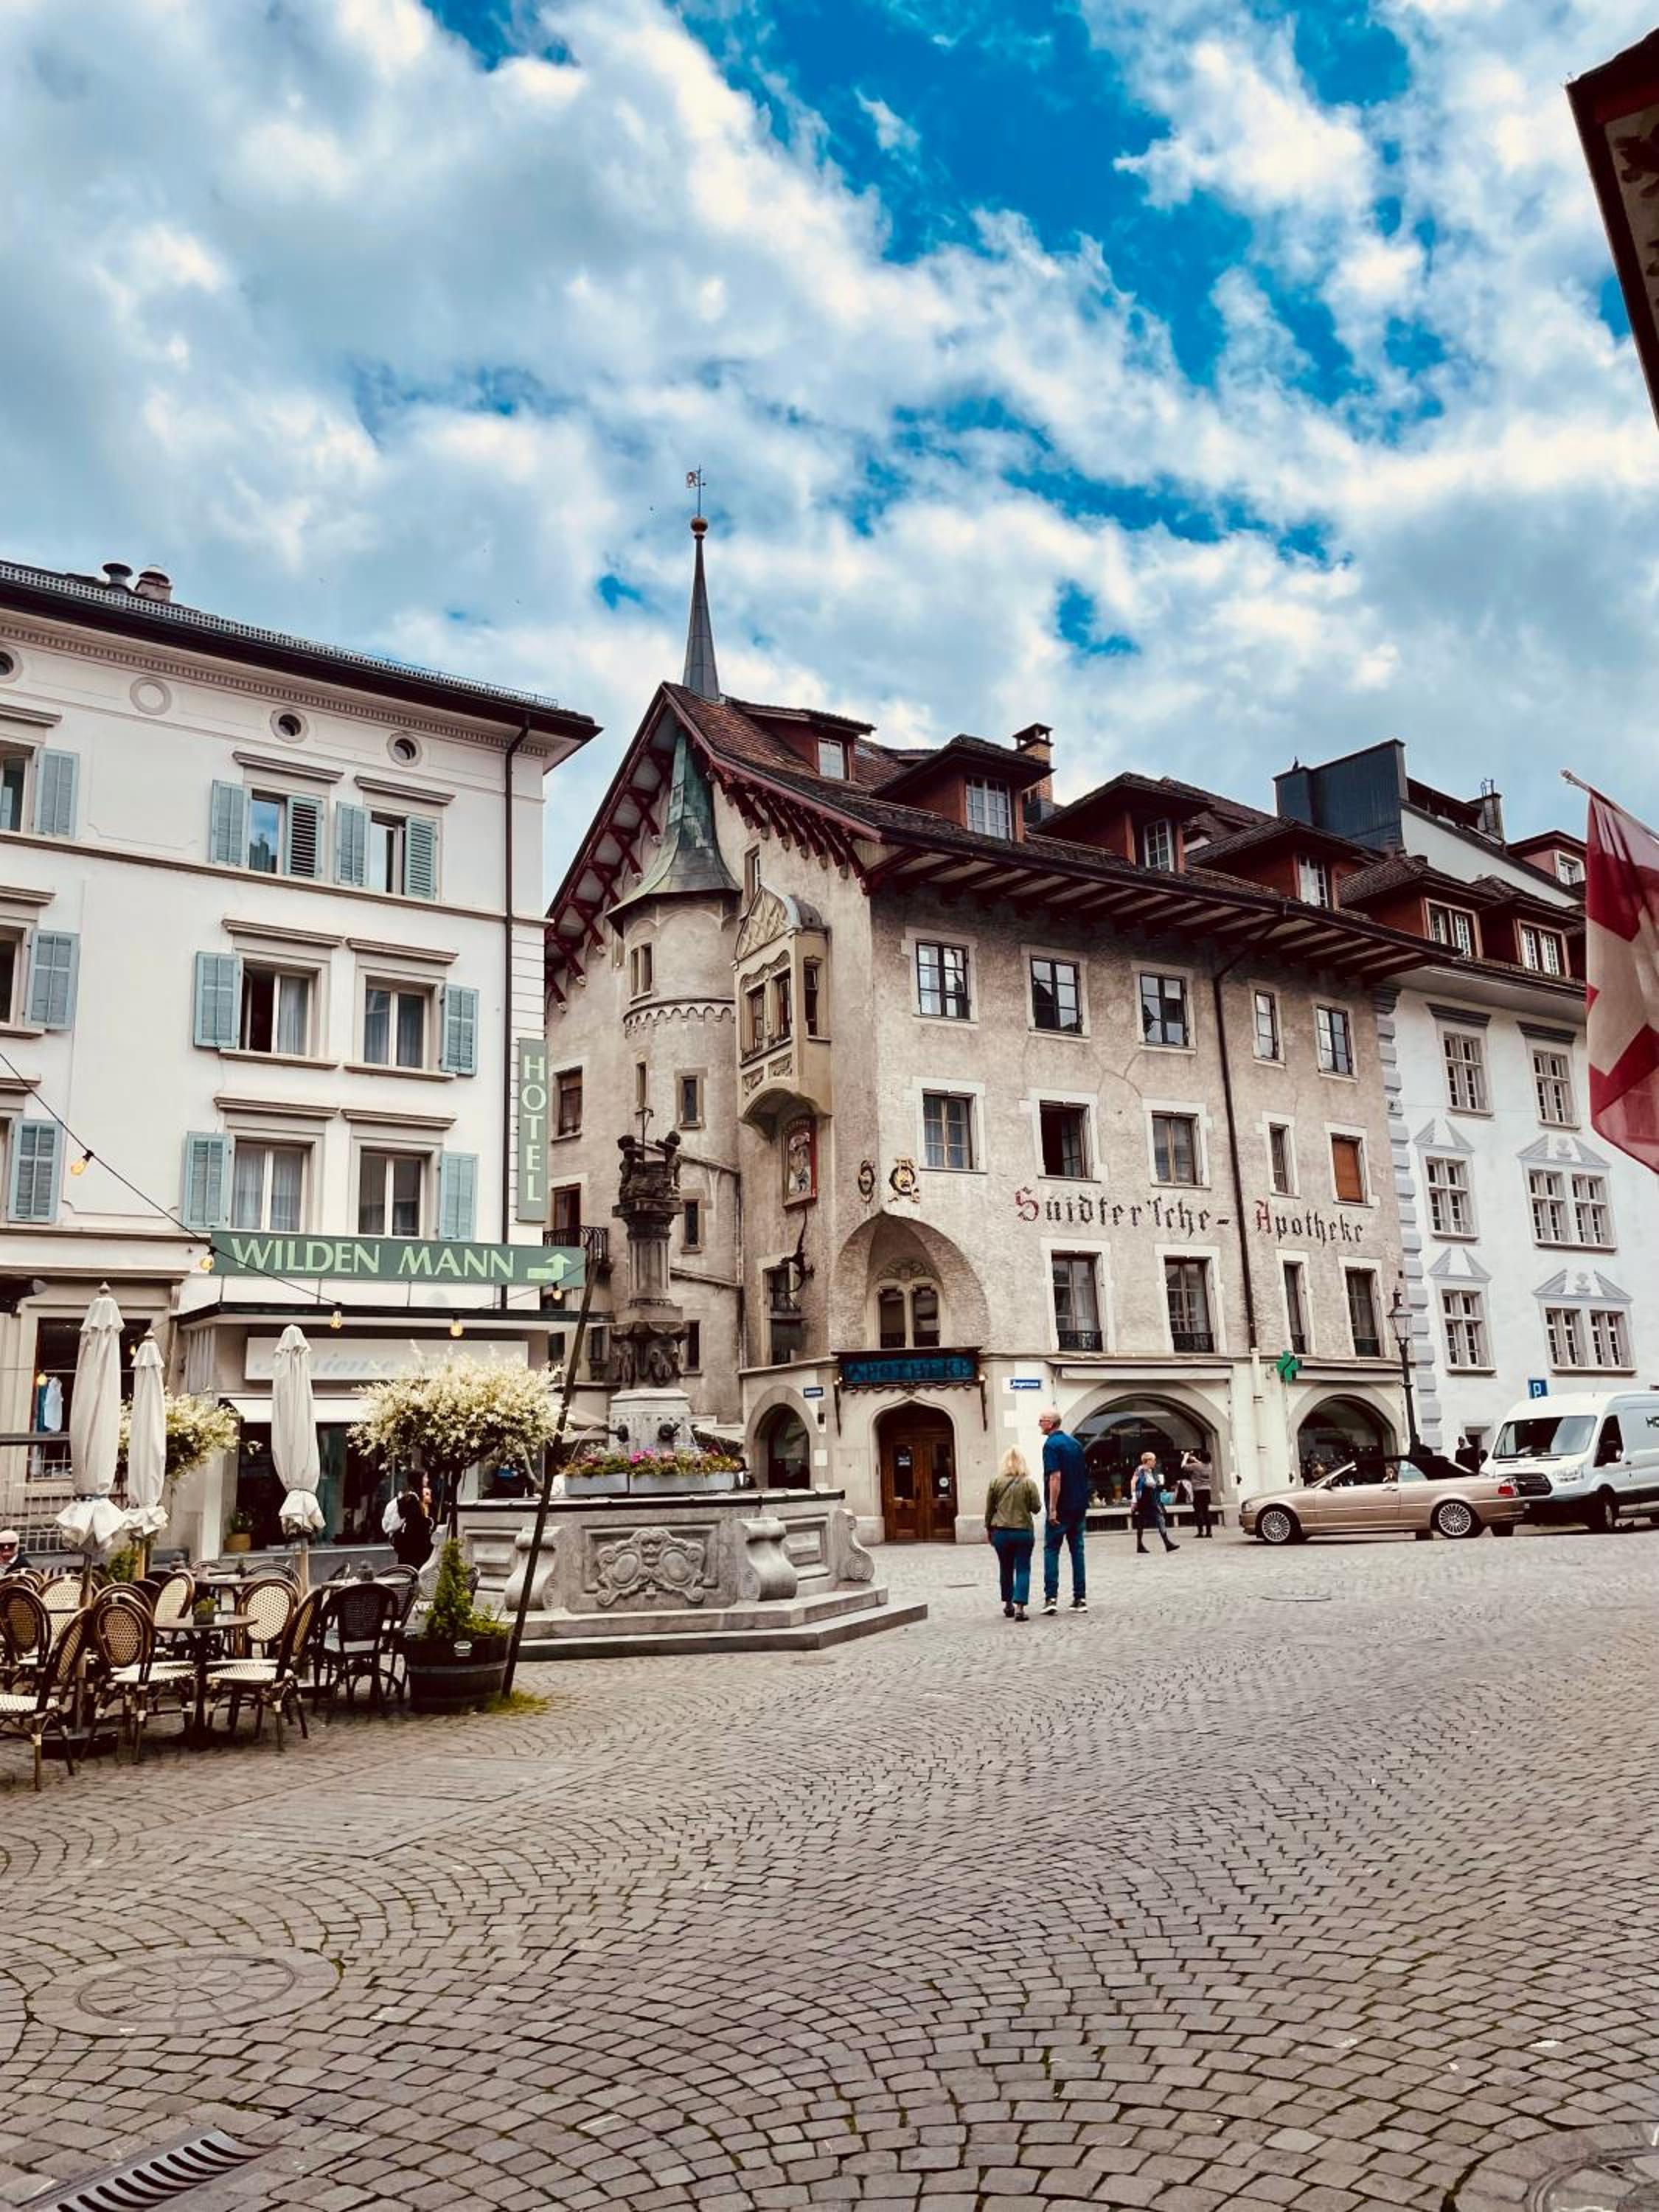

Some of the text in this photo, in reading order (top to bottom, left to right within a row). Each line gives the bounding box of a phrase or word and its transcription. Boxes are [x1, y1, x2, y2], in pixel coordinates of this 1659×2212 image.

[521, 1055, 546, 1201] HOTEL
[1254, 1200, 1363, 1247] Apotheke
[231, 1238, 515, 1279] WILDEN MANN
[1533, 1382, 1542, 1398] P
